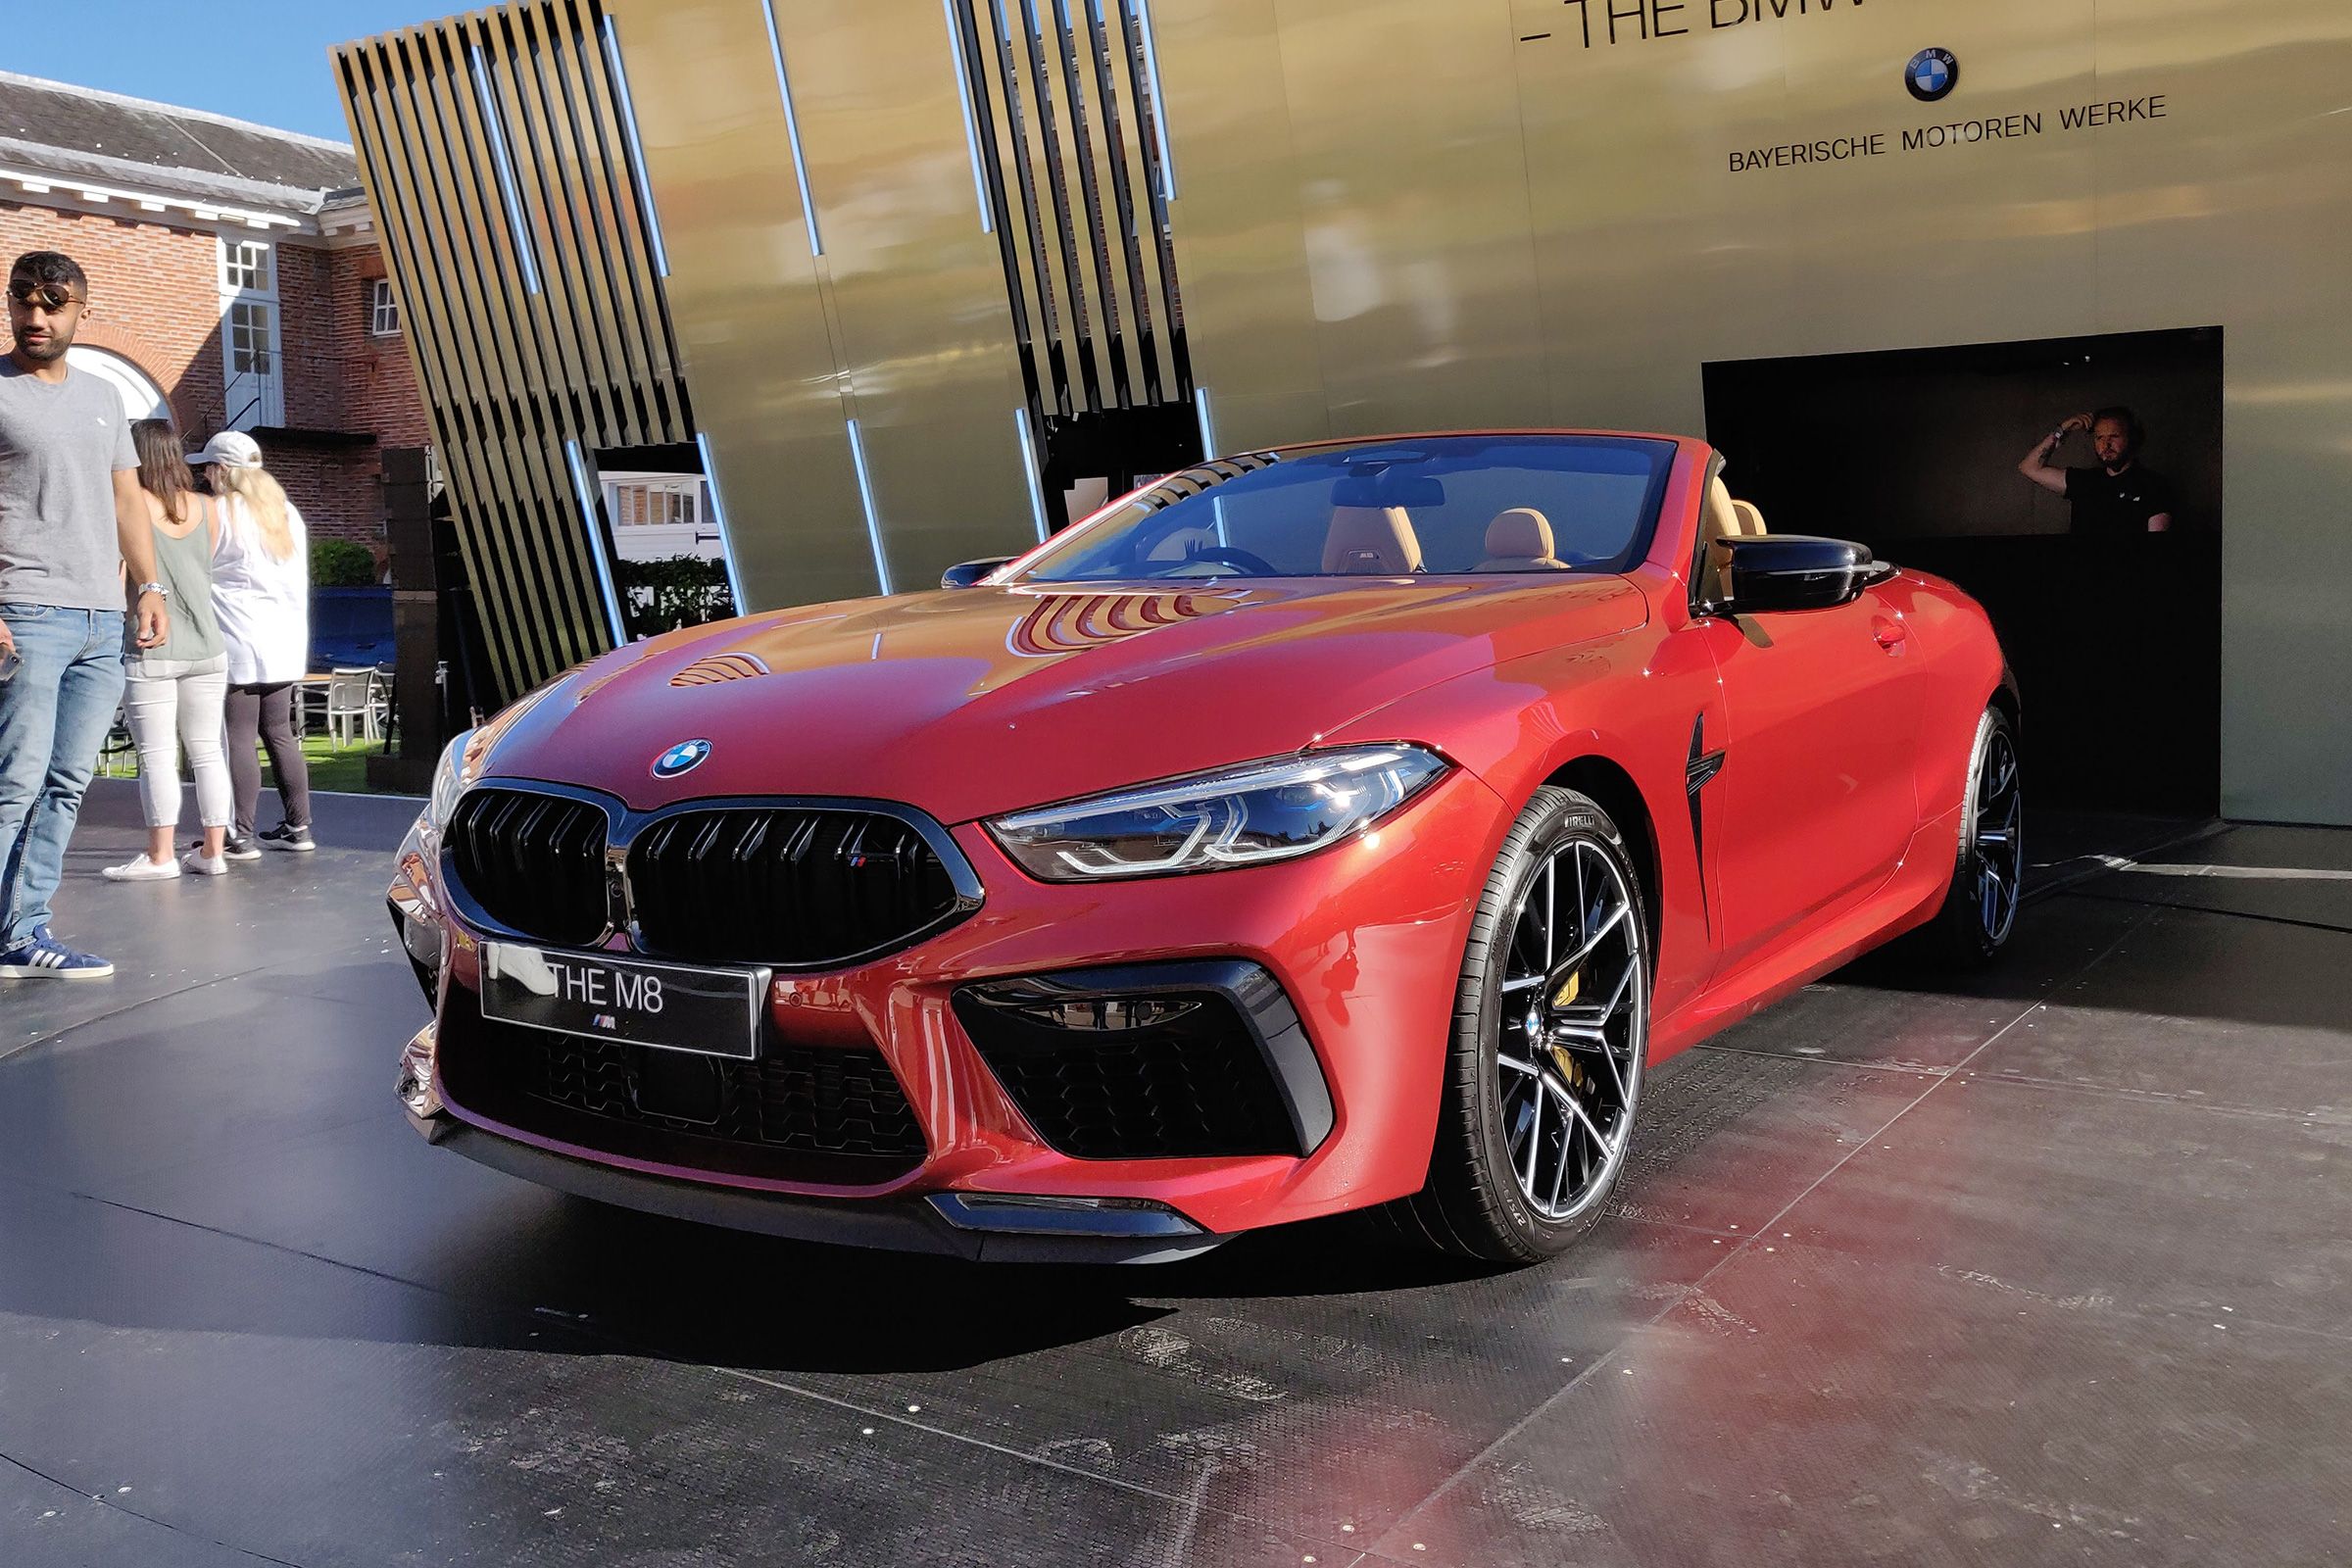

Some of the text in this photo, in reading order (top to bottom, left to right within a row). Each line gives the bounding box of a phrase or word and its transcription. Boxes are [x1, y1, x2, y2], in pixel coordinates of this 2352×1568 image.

[1564, 0, 1689, 48] THE
[1910, 49, 1954, 71] BMW
[1729, 95, 2167, 172] BAYERISCHE MOTOREN WERKE
[547, 962, 664, 1014] THE M8
